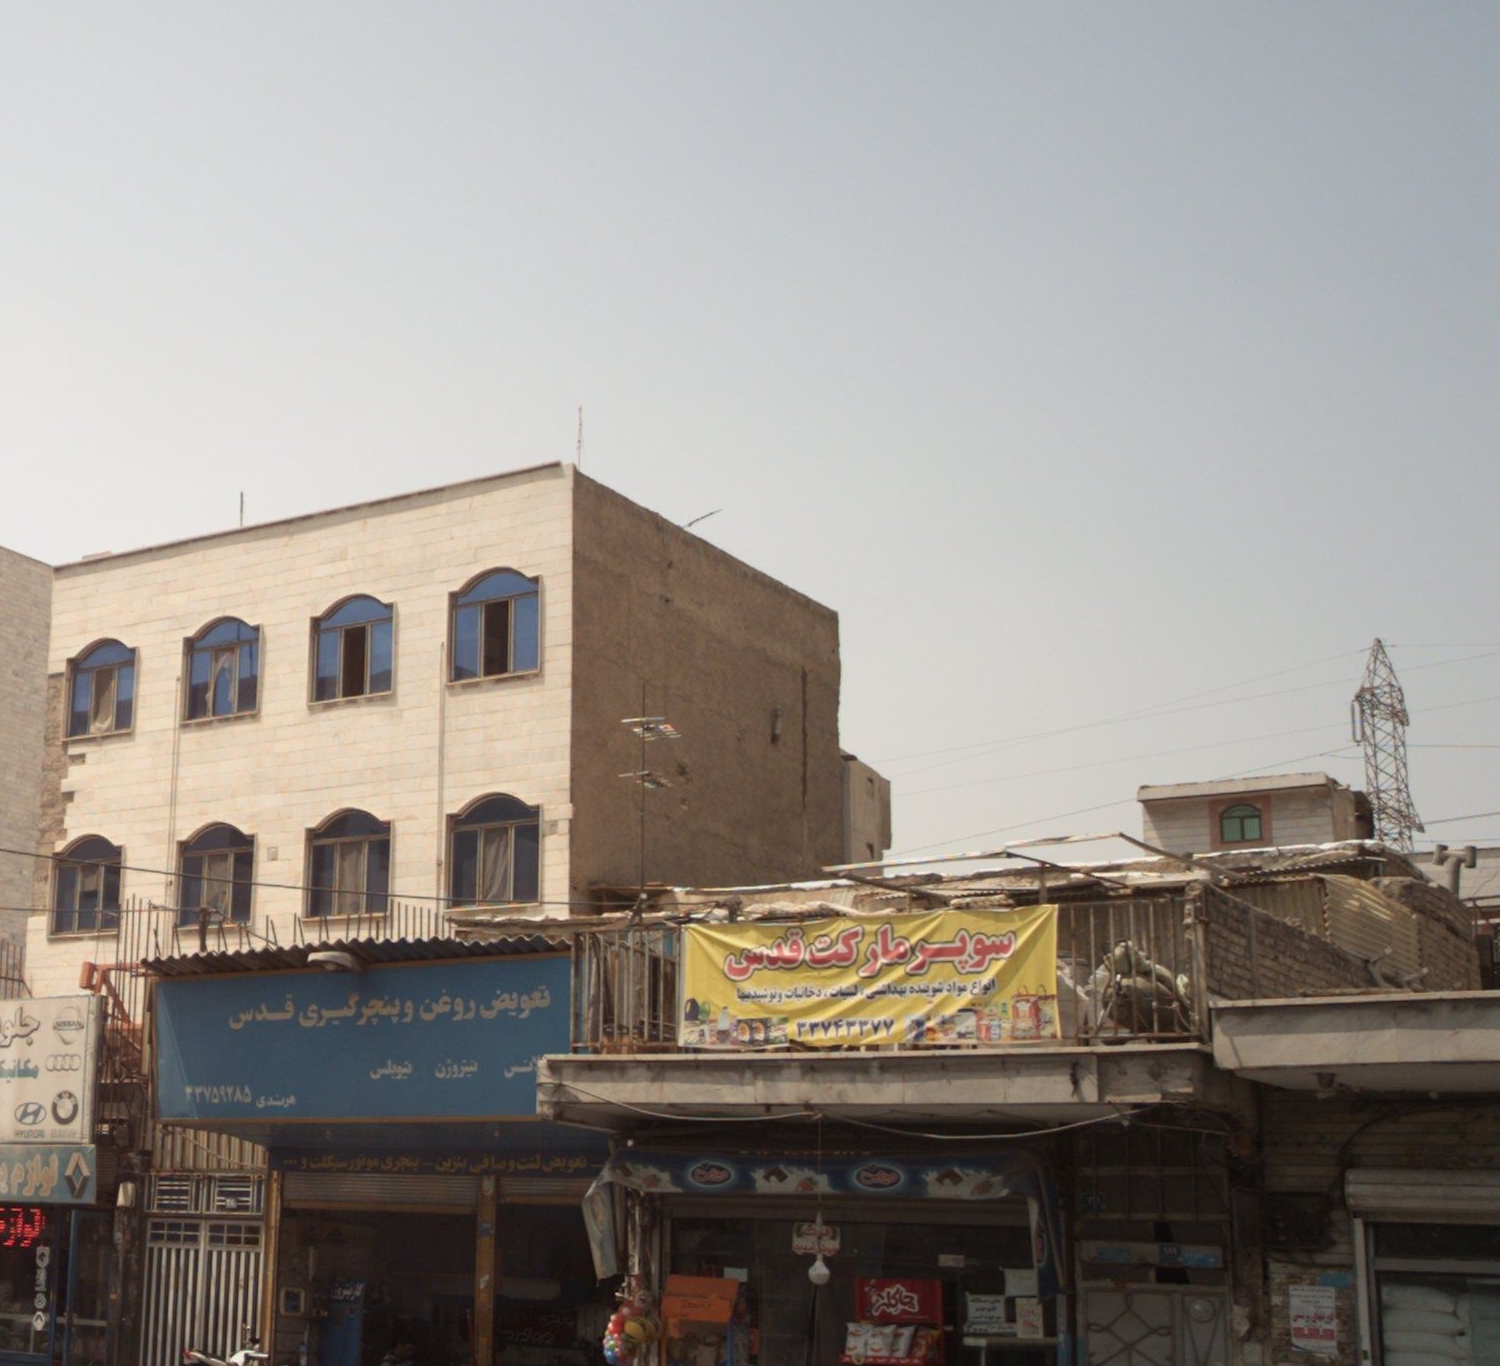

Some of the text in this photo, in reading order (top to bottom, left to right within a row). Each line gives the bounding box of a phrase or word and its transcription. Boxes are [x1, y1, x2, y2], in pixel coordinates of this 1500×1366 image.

[724, 922, 1016, 982] سوپر مارکت قدس
[946, 981, 968, 997] مواد
[970, 978, 996, 996] انواع
[228, 993, 295, 1031] قدس
[419, 988, 476, 1022] روغن
[479, 985, 551, 1020] تعویض
[797, 1018, 894, 1038] ۳۳۷۴۳۳۷۷
[434, 1057, 479, 1079] نیتروژن
